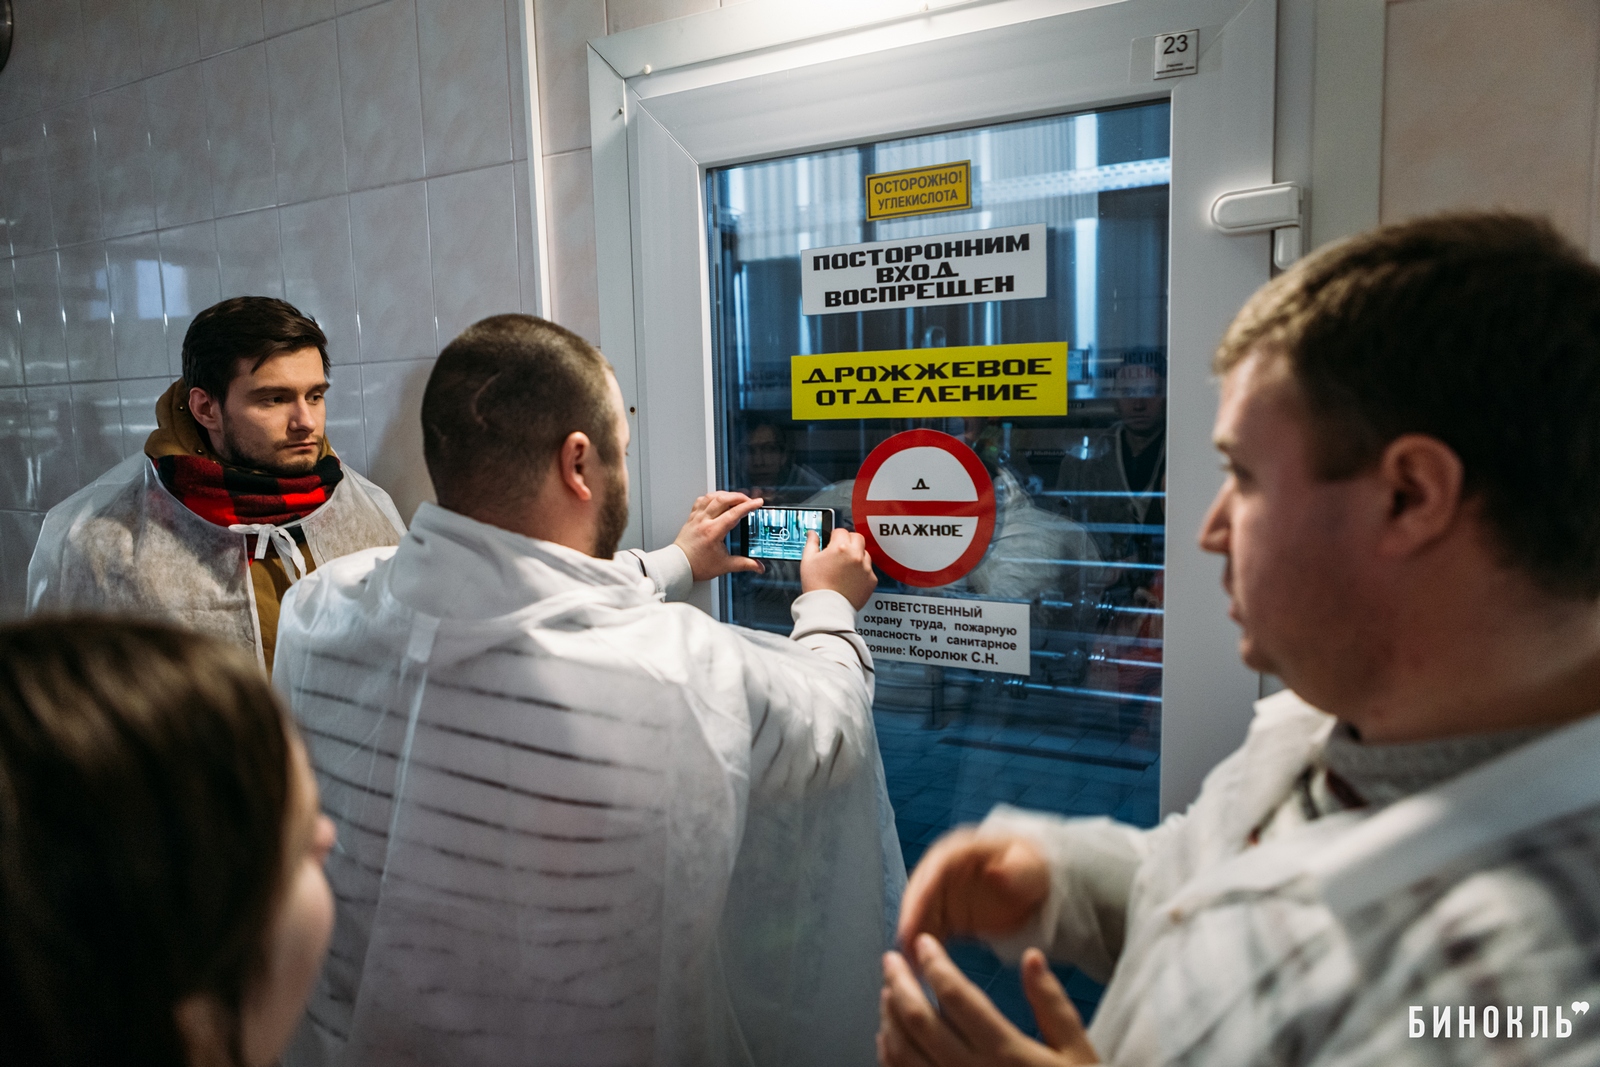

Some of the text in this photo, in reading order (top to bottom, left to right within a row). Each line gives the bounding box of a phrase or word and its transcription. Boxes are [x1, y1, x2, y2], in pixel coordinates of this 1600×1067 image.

[1163, 34, 1188, 55] 23
[874, 170, 963, 195] ОСТОРОЖНО!
[877, 188, 958, 211] УГЛЕКИСЛОТА
[812, 233, 1030, 271] ПОСТОРОННИМ
[876, 261, 960, 284] ВХОД
[824, 275, 1015, 308] ВОСПРЕЩЕН
[801, 357, 1053, 384] ДРОЖЖЕВОЕ
[815, 383, 1038, 406] ОТДЕЛЕНИЕ
[911, 478, 930, 490] Д
[879, 523, 963, 537] ВЛАЖНОЕ
[874, 600, 983, 619] ОТВЕТСТВЕННЫЙ
[863, 614, 1017, 637] охрану труда, пожарную
[855, 627, 1017, 651] зопасность и санитарное
[909, 645, 968, 662] Королюк
[971, 651, 999, 665] С.Н.
